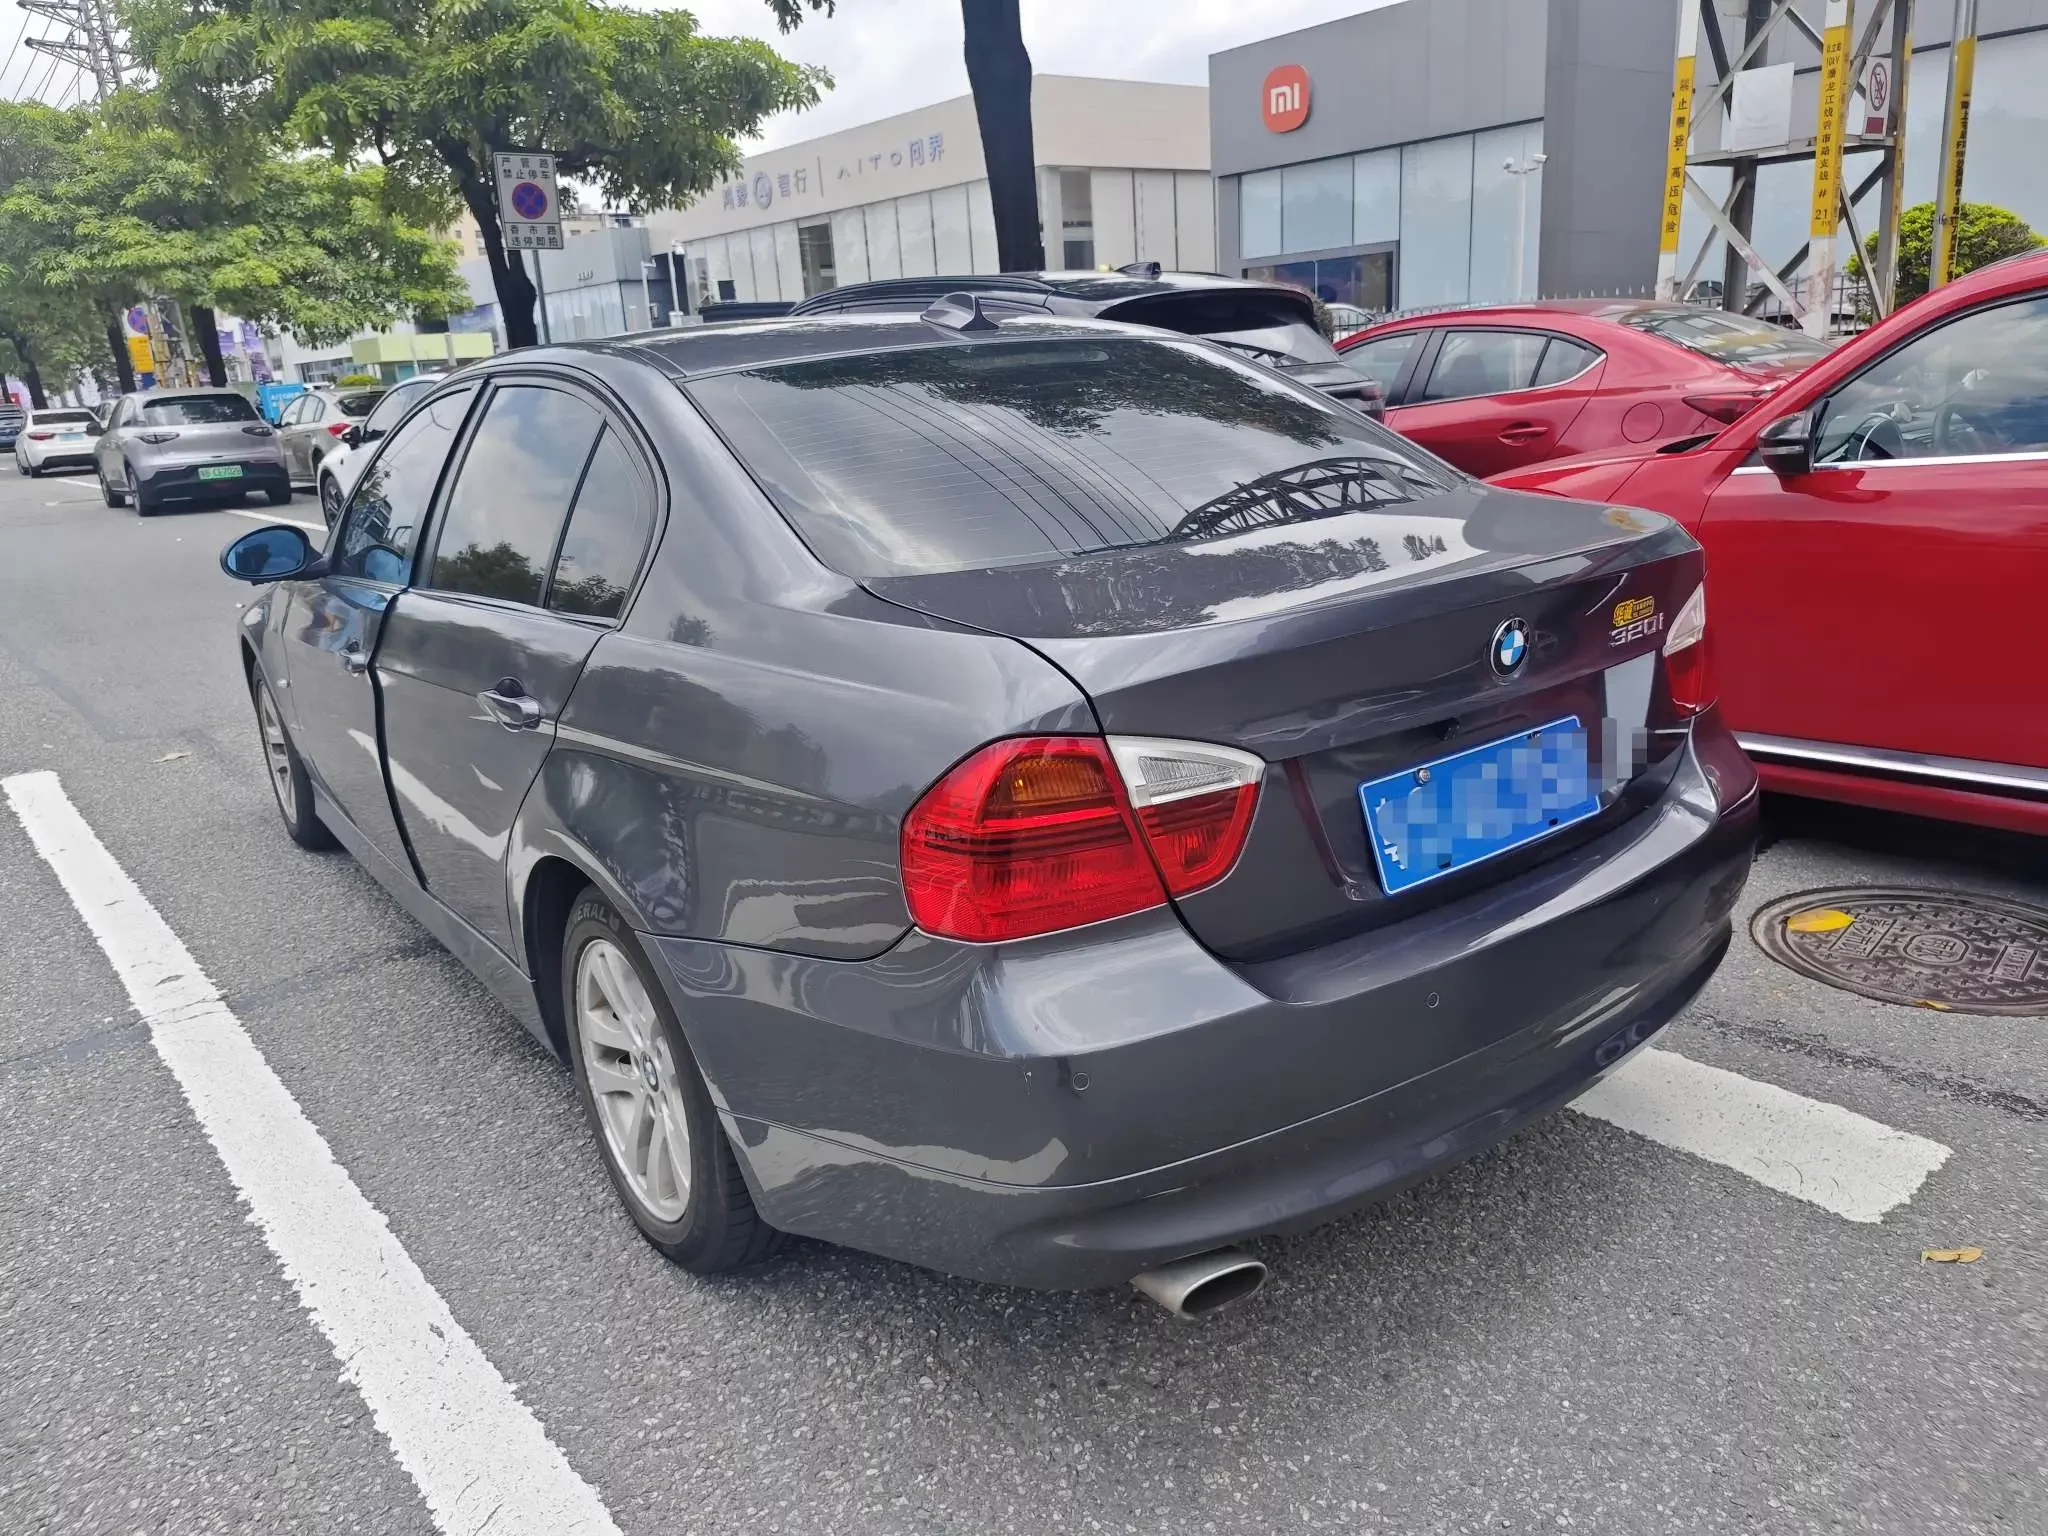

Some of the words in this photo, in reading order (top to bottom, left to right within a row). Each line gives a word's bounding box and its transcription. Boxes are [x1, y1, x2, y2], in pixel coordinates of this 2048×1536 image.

[503, 168, 553, 180] 禁止停车
[1608, 612, 1665, 648] 320i
